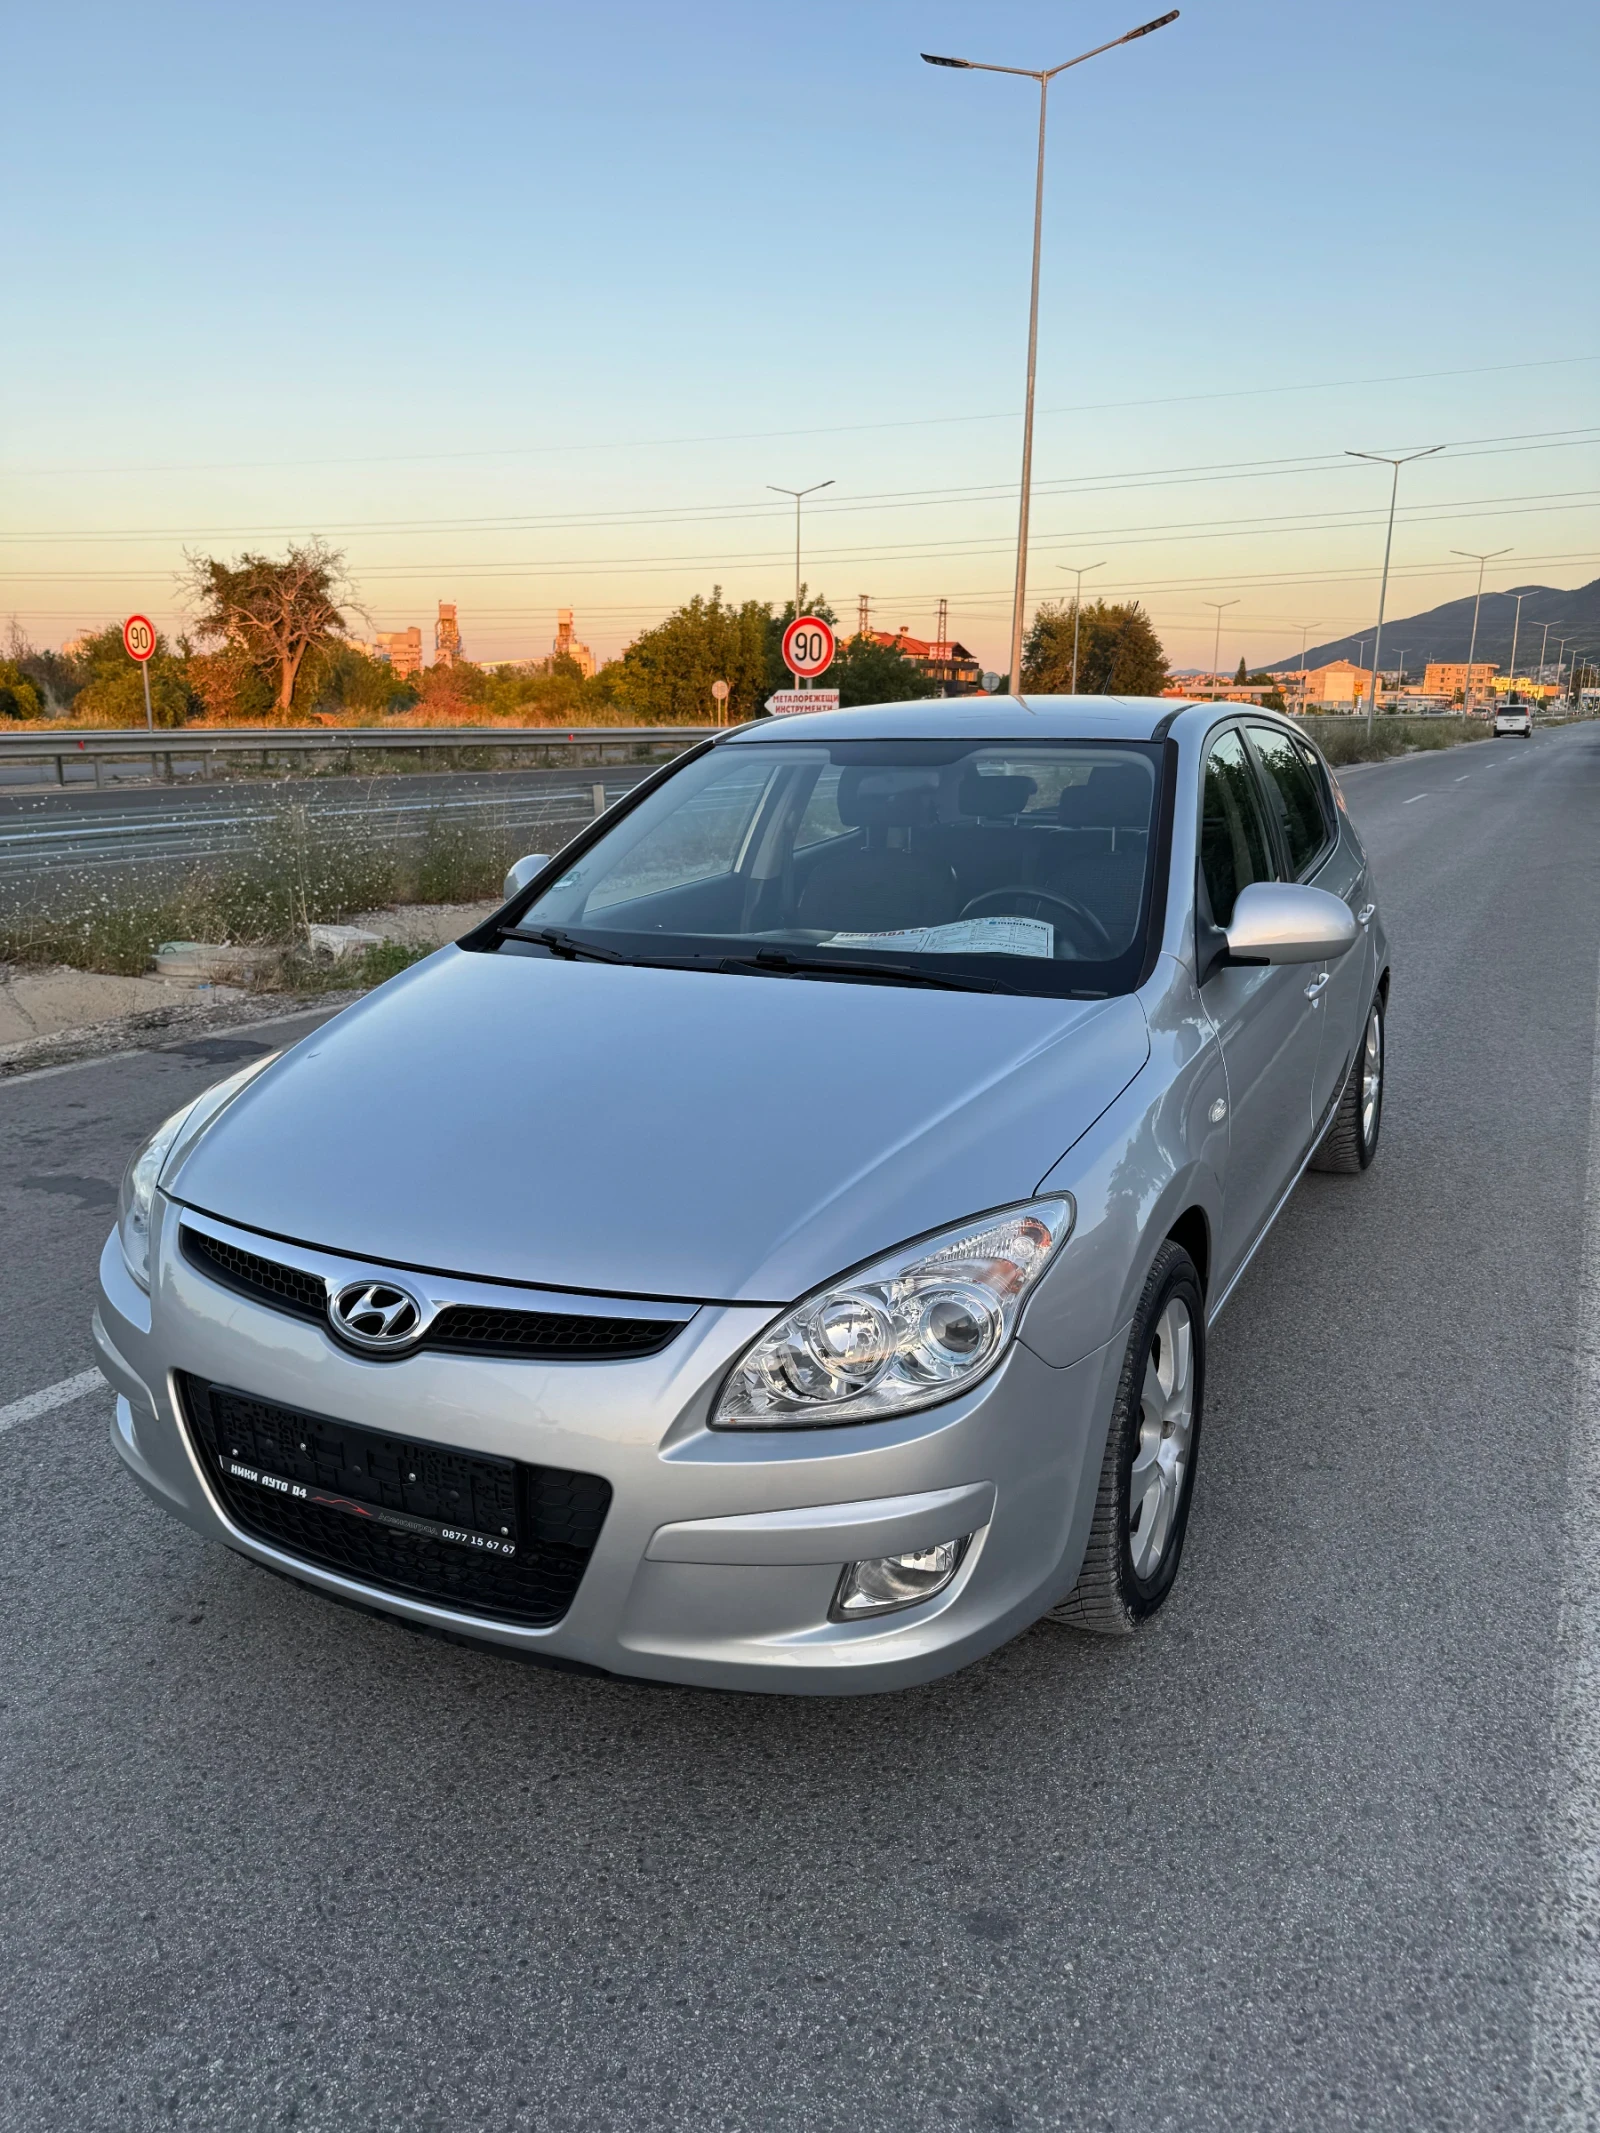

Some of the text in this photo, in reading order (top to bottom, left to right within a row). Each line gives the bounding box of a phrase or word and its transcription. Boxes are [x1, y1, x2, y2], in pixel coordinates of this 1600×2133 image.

[131, 627, 148, 648] 90
[795, 632, 822, 662] 90
[773, 694, 839, 703] МЕТАЛОРЕЖЕЩИ
[775, 705, 833, 713] ИНСТРУМЕНТИ
[231, 1464, 258, 1481] НИКИ
[262, 1475, 288, 1492] АУТО
[442, 1529, 468, 1542] 0877
[470, 1535, 484, 1546] 15
[486, 1540, 499, 1550] 67
[502, 1544, 516, 1554] 67
